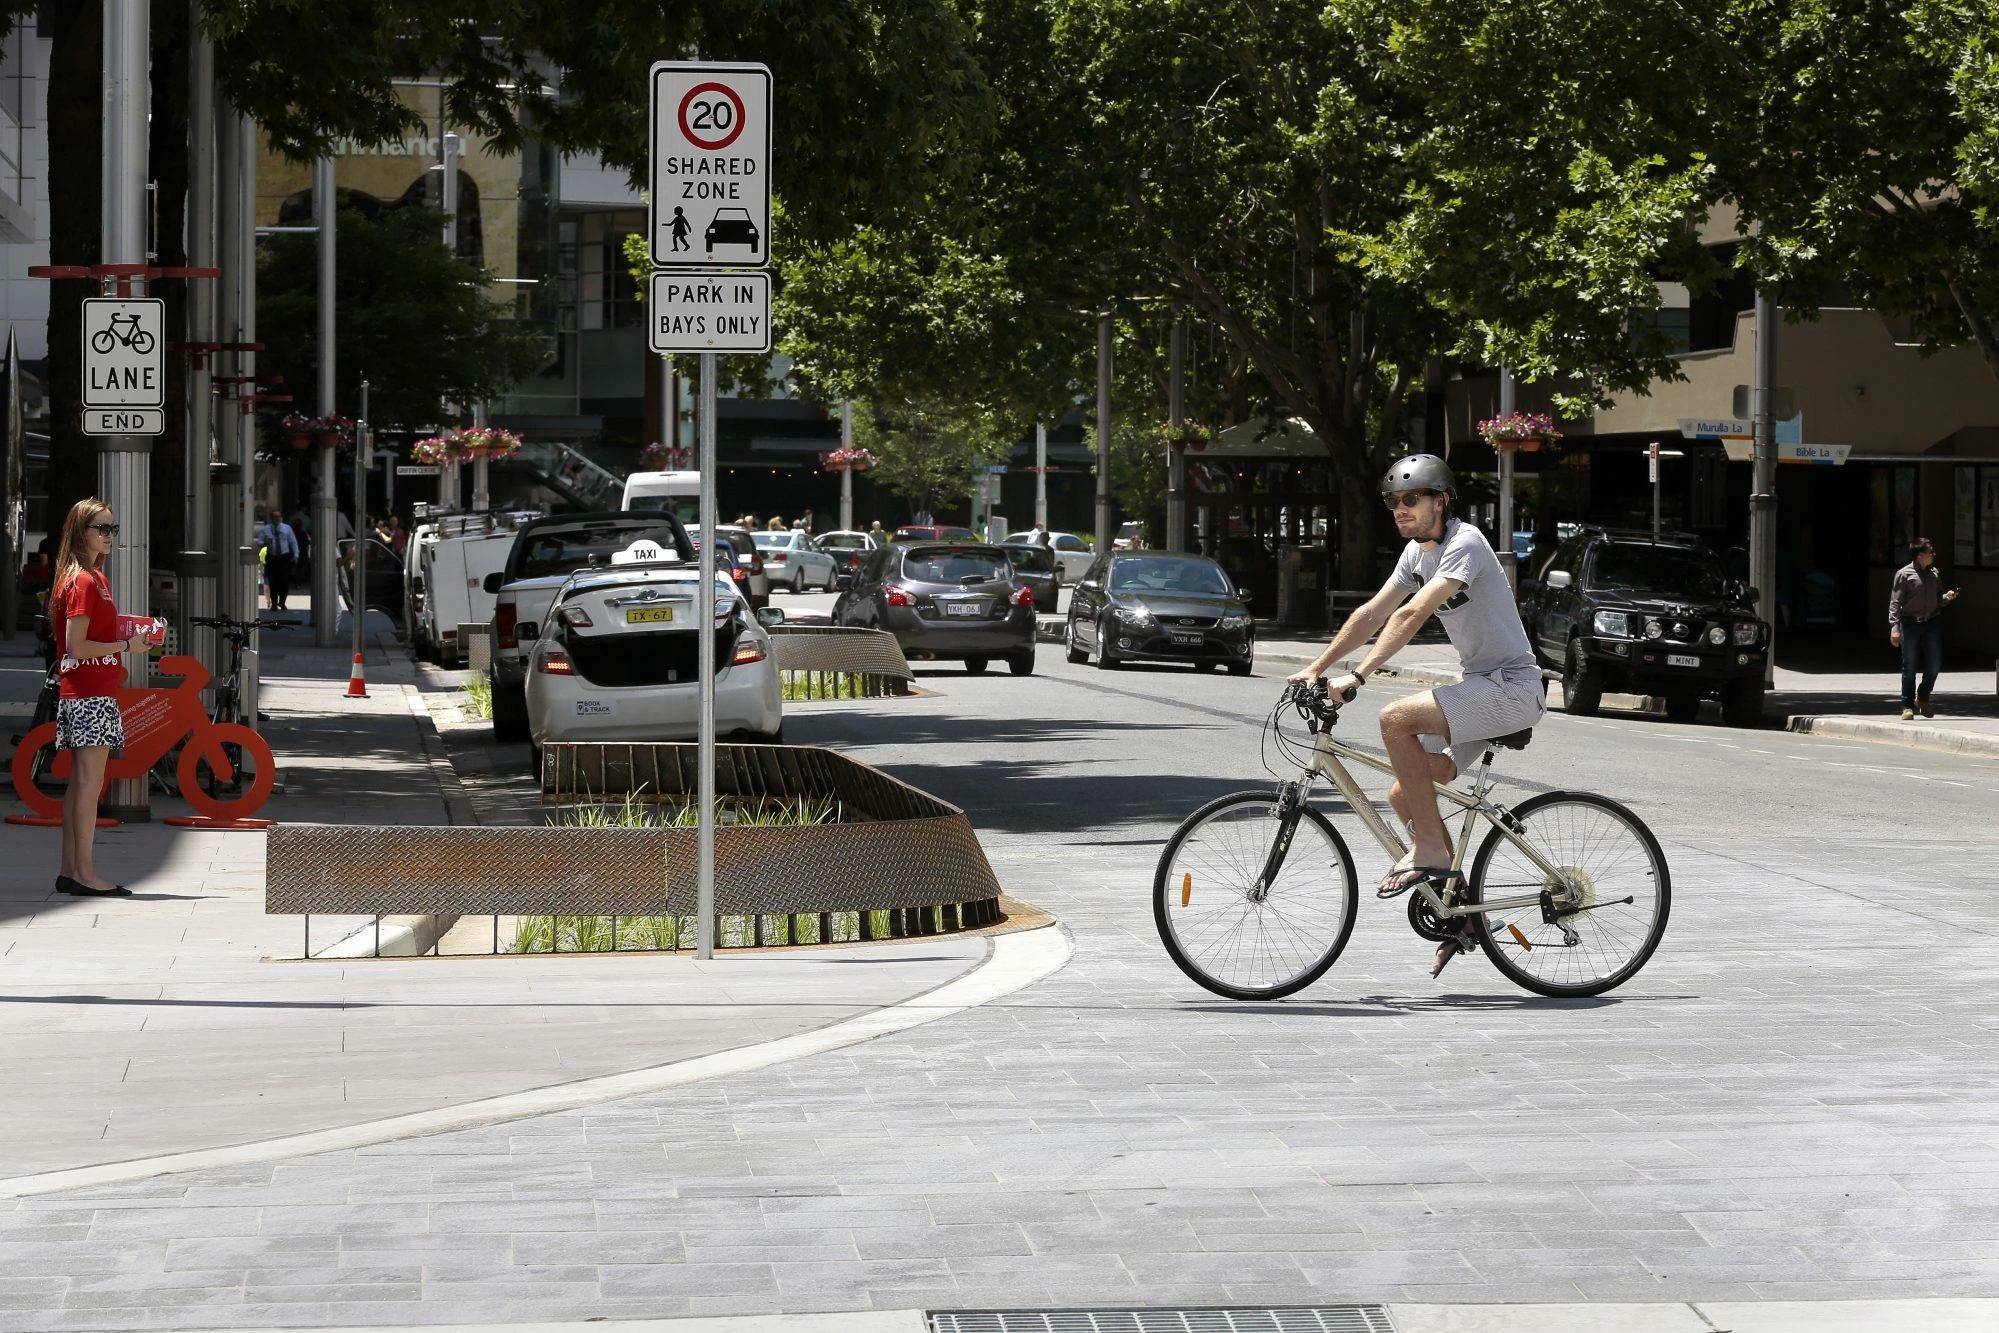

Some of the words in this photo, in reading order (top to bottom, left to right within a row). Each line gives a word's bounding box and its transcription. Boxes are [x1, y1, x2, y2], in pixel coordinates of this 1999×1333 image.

[693, 101, 732, 130] 20
[666, 157, 756, 175] SHARED
[682, 182, 740, 199] ZONE
[668, 285, 723, 303] PARK
[734, 286, 753, 303] IN
[660, 316, 706, 334] BAYS
[716, 316, 760, 334] ONLY
[91, 367, 155, 390] LANE
[102, 414, 144, 429] END
[1697, 422, 1729, 433] Murulla
[1732, 423, 1743, 433] La
[1796, 447, 1816, 457] Bible
[1819, 448, 1830, 457] La
[634, 549, 657, 560] TAXI
[1675, 656, 1695, 666] MINT
